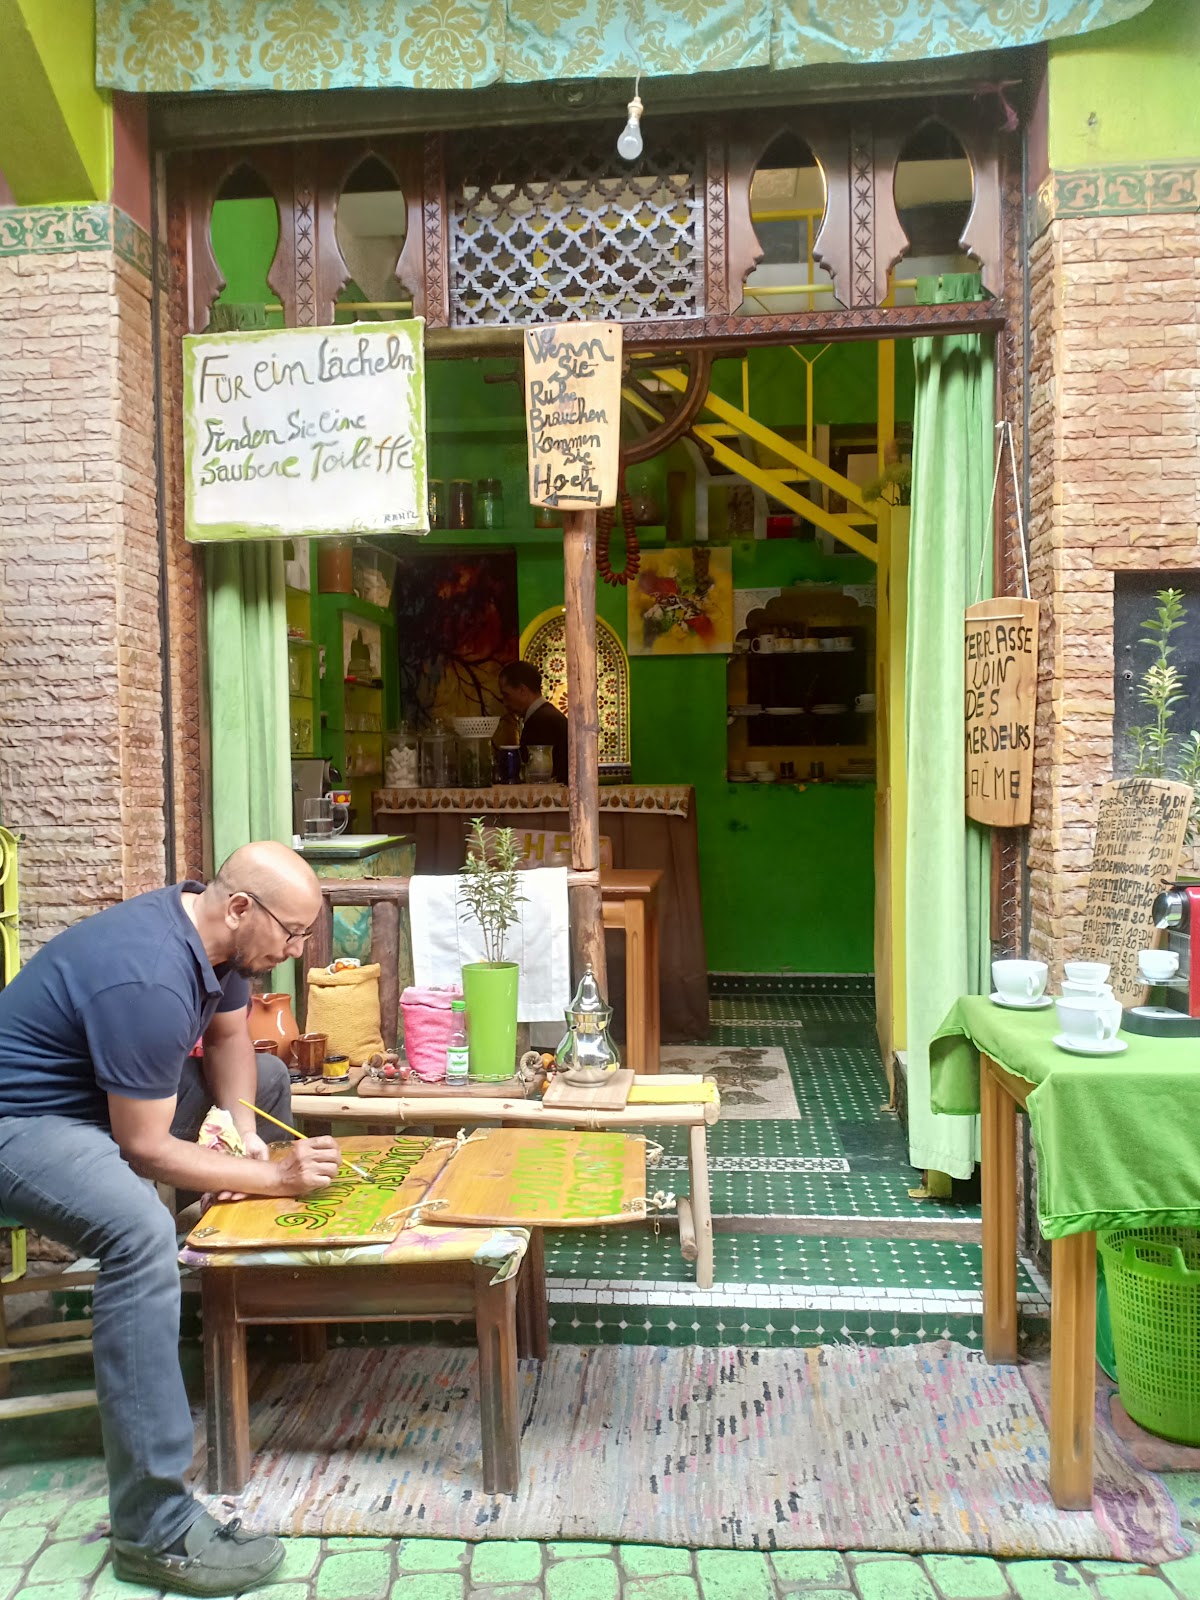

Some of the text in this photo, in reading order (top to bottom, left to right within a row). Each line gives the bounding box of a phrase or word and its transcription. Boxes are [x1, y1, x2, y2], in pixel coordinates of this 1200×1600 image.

[254, 353, 314, 391] ein
[318, 334, 414, 382] Lächeln
[525, 327, 614, 364] Wenn
[548, 355, 595, 384] Sie
[531, 380, 577, 408] Ruhe
[530, 397, 608, 433] Brauchen
[201, 416, 285, 456] Finden
[287, 409, 316, 440] Sie
[532, 431, 601, 458] Kommen
[311, 434, 415, 481] Toilette
[564, 449, 592, 466] Sie
[534, 464, 599, 498] Hoch
[972, 655, 1016, 690] LOIN
[965, 689, 1000, 720] DES
[965, 766, 1020, 801] ALME
[1173, 795, 1186, 808] DH
